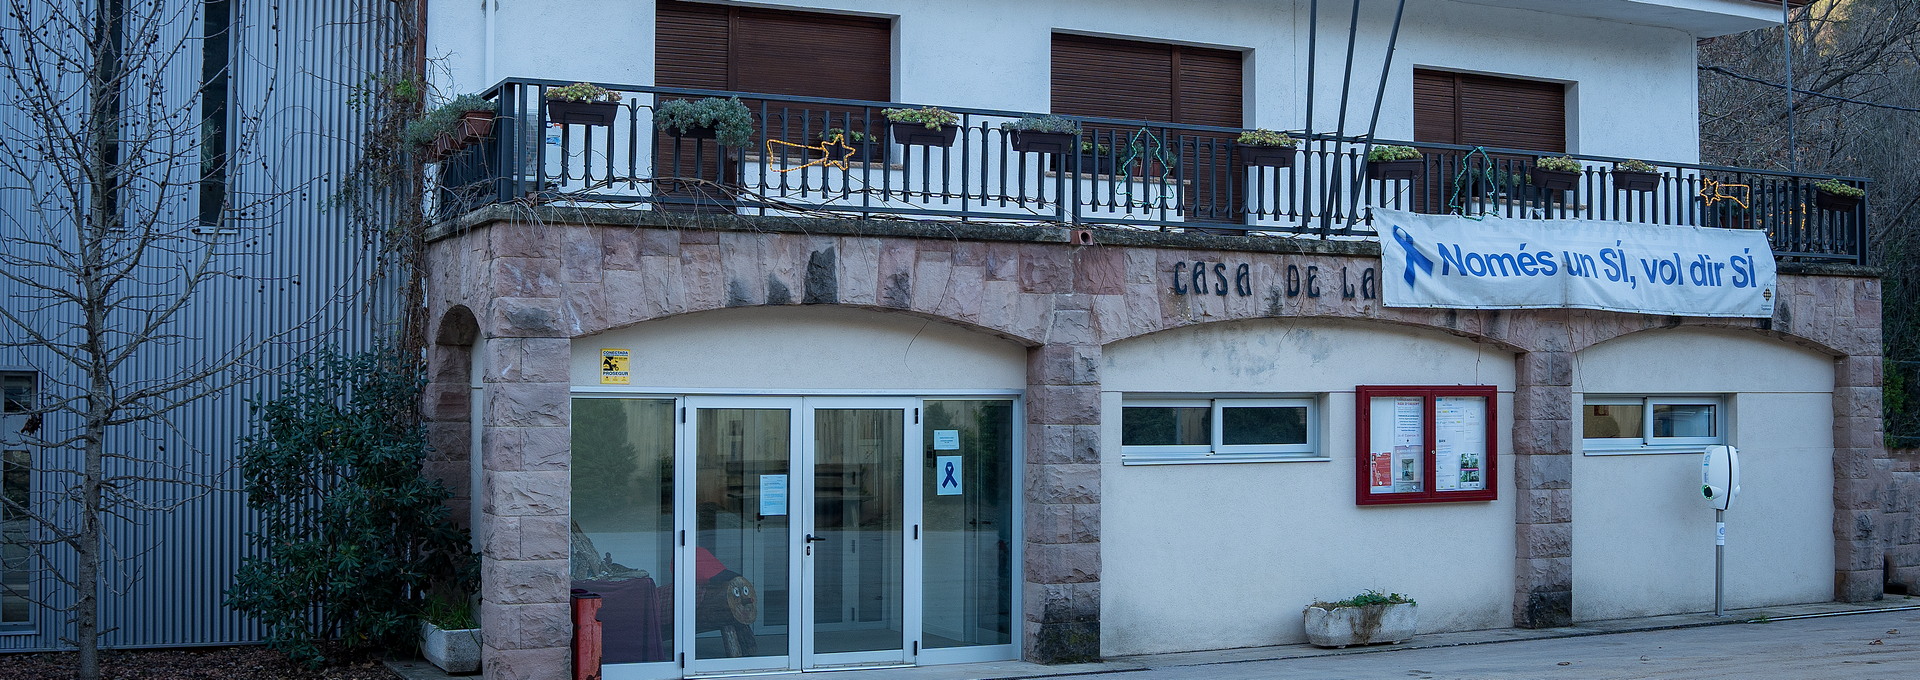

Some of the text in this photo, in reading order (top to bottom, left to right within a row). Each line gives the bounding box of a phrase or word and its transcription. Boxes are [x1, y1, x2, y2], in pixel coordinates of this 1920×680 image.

[1174, 261, 1377, 301] CASA DE LA
[1437, 240, 1757, 289] Només un SÍ, vol dir SÍ
